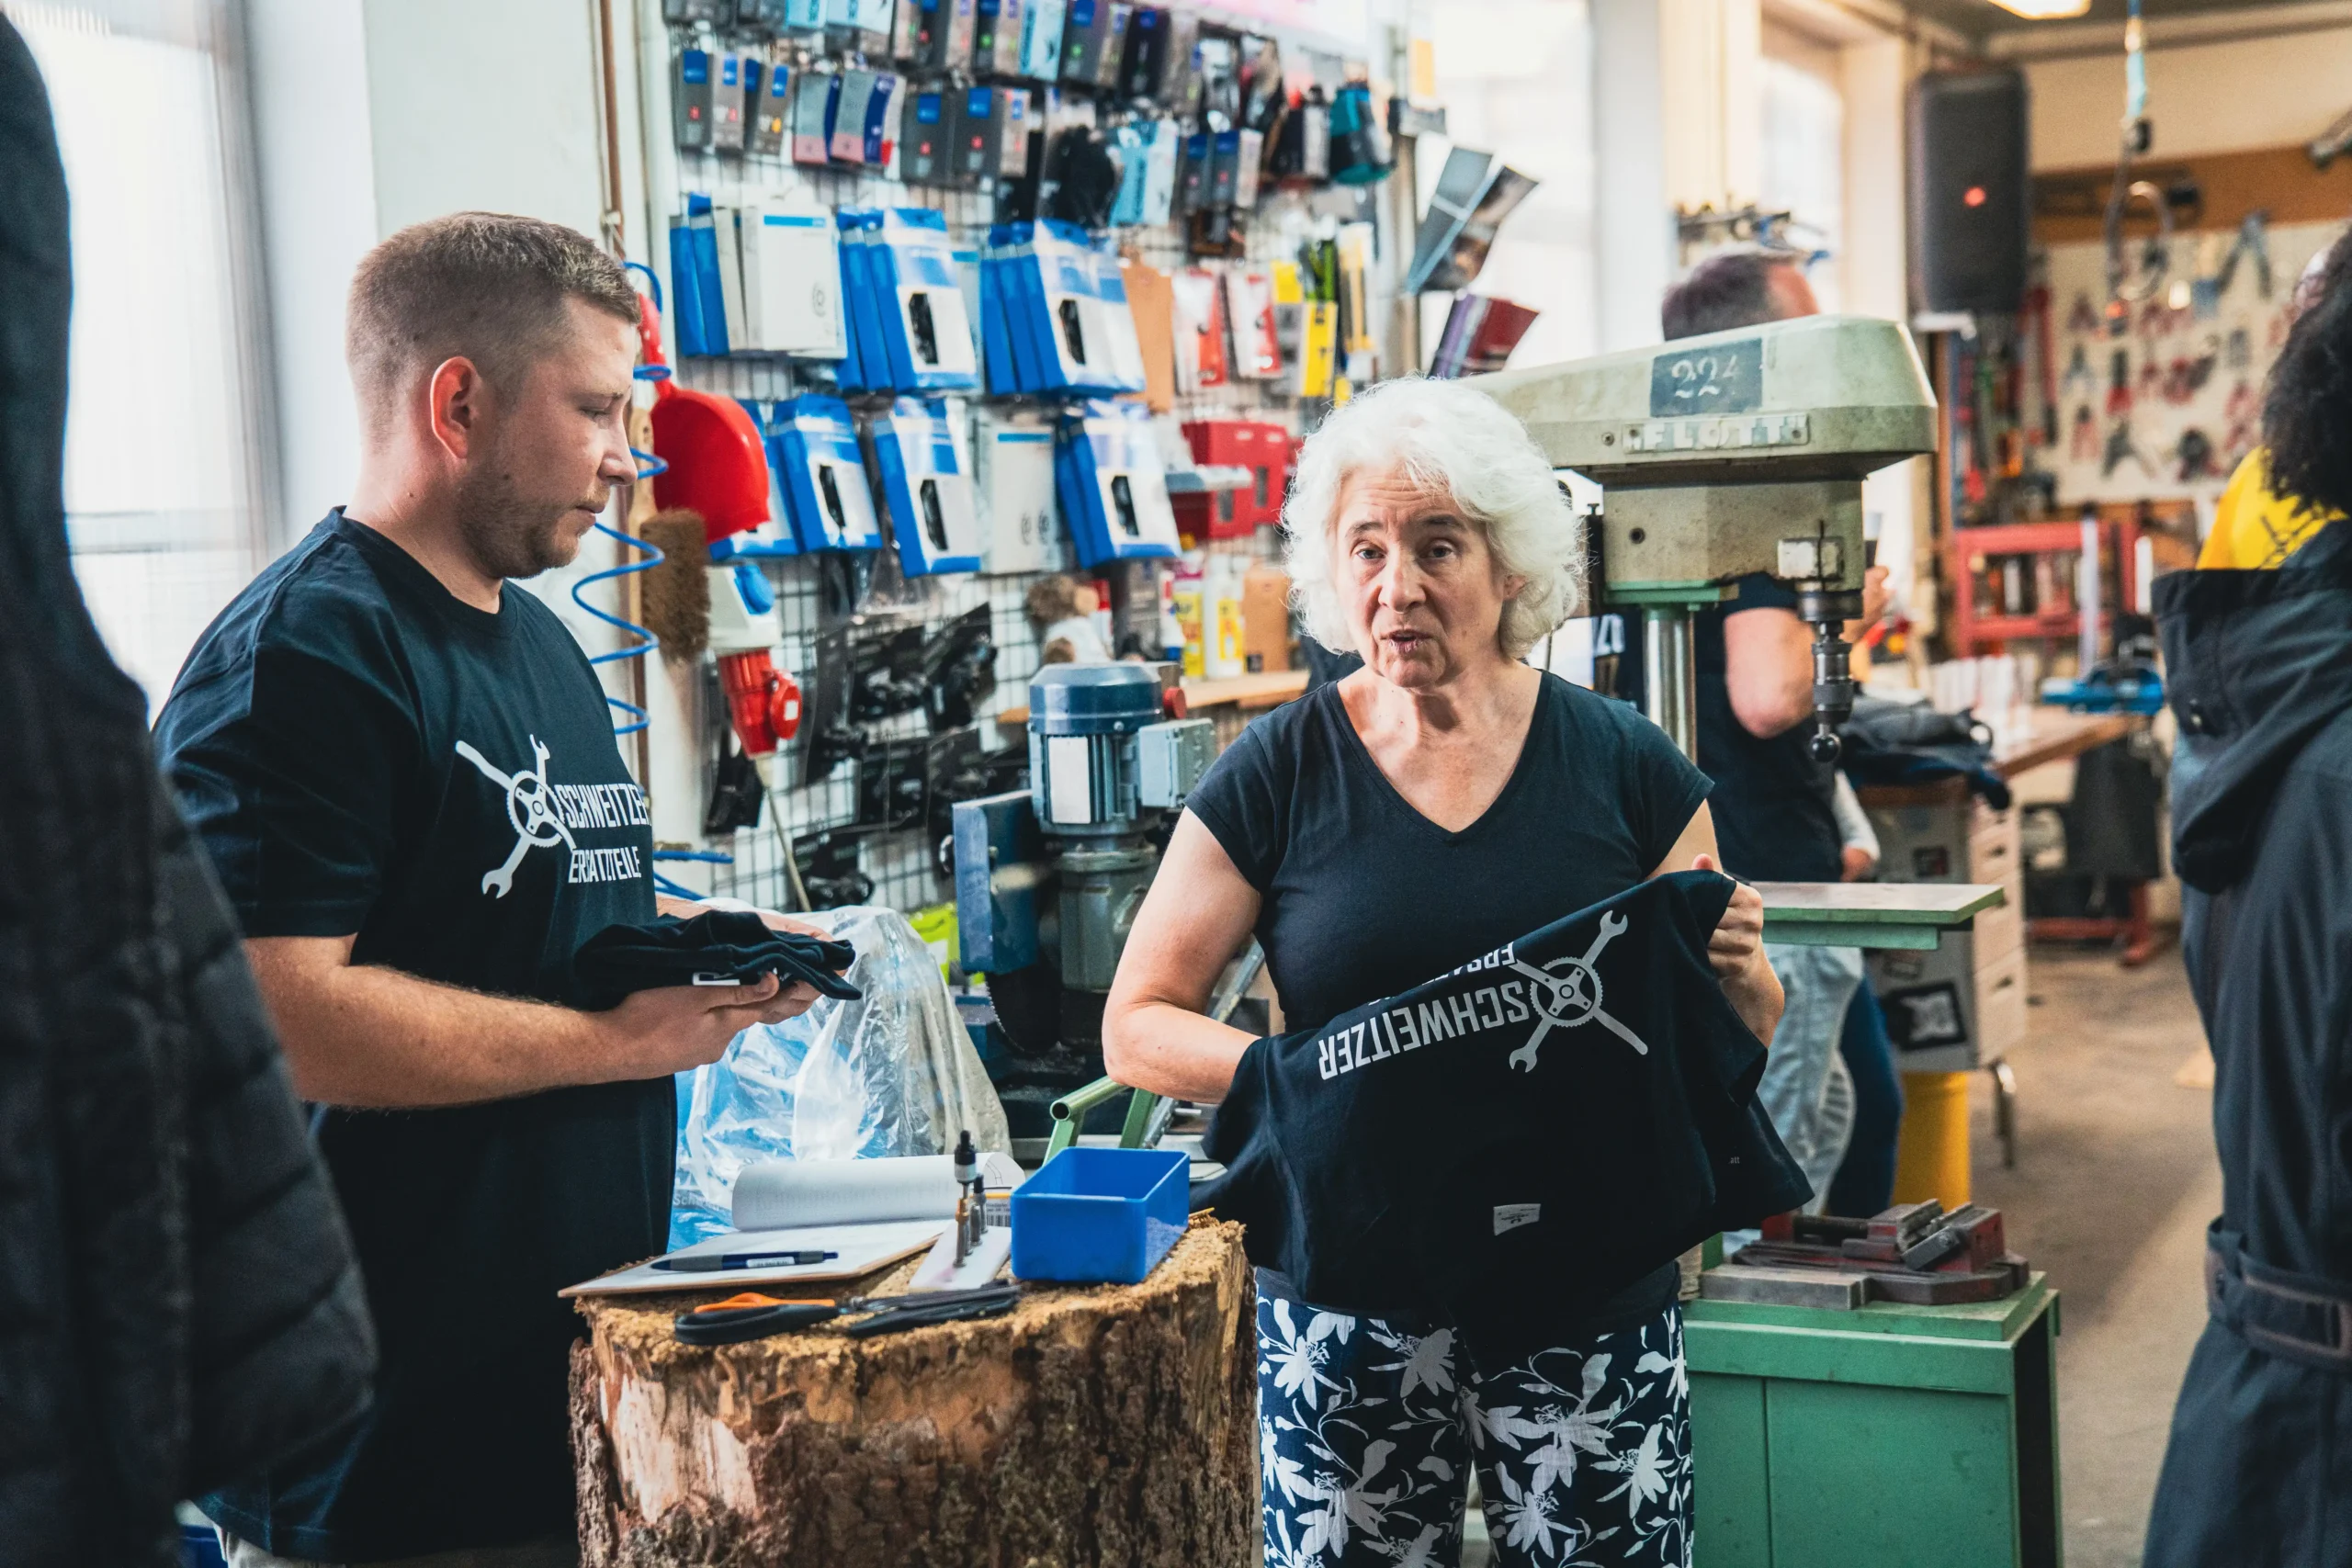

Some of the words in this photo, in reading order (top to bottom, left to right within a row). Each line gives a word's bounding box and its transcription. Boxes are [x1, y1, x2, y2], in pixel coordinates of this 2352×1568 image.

[1644, 416, 1788, 451] FLOTT
[553, 783, 651, 829] SCHWEITZE
[1317, 980, 1531, 1081] SCHWEITZER
